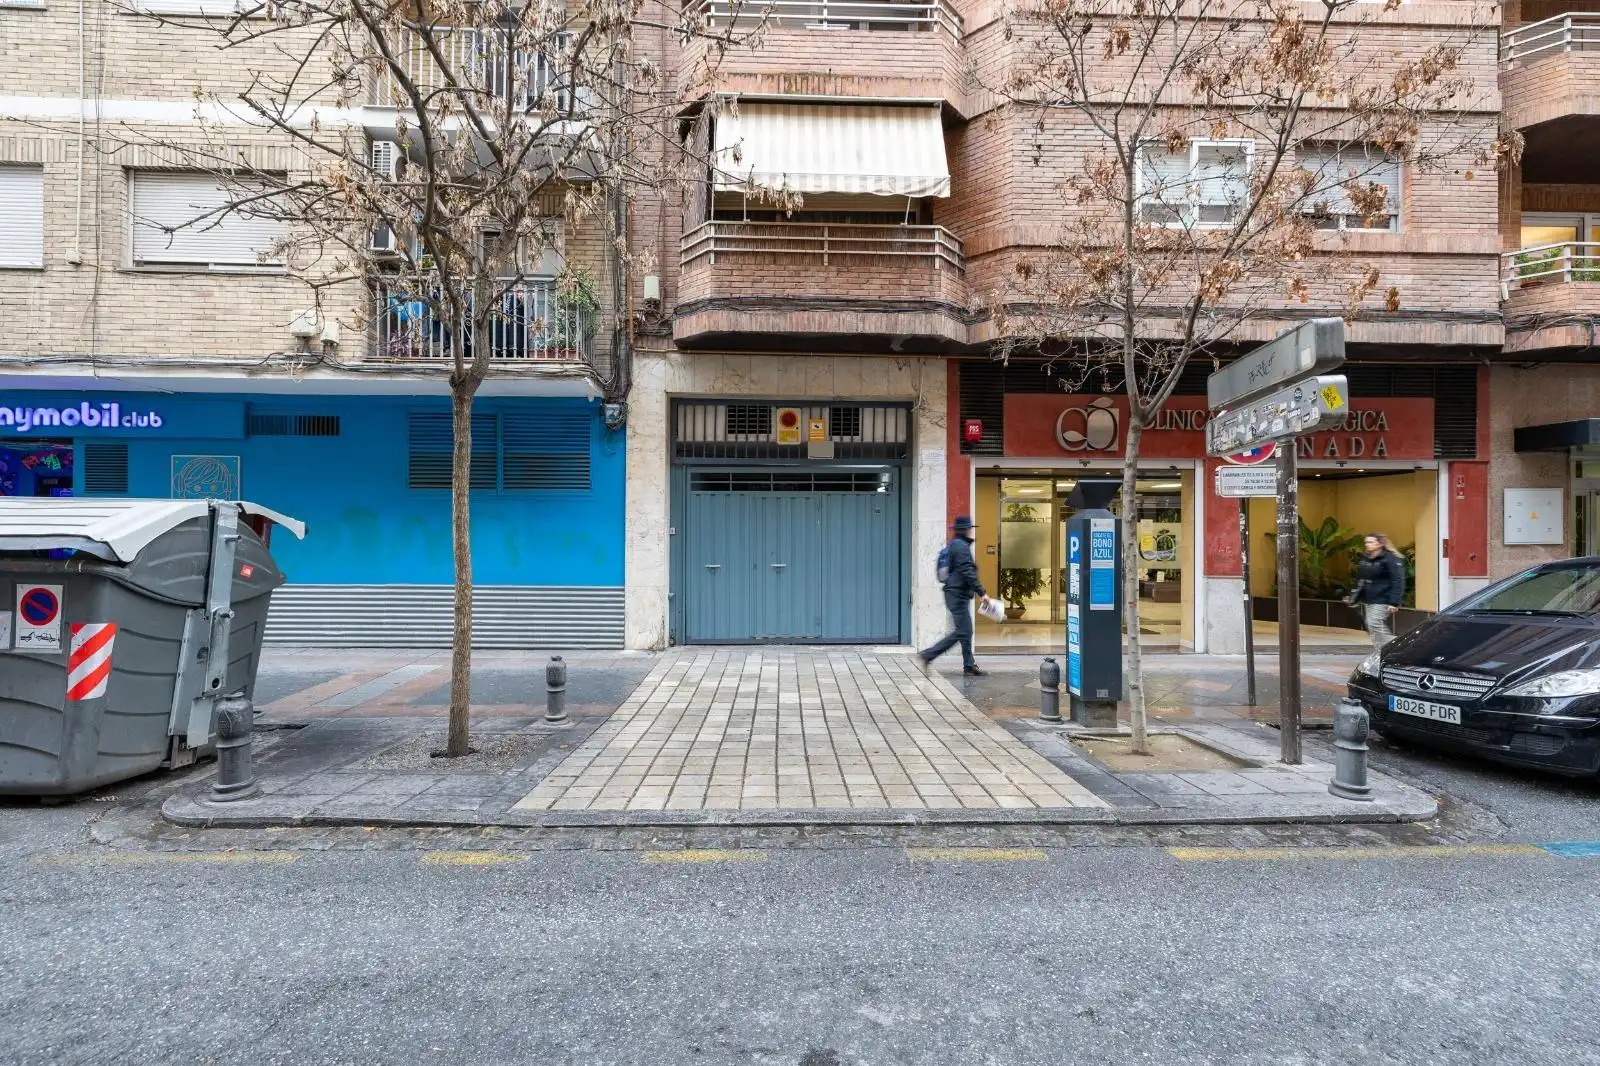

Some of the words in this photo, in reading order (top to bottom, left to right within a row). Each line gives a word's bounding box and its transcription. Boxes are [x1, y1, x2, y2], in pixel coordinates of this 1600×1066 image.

[121, 411, 162, 428] club
[1070, 536, 1080, 558] P
[1093, 538, 1113, 548] BONO
[1093, 548, 1113, 559] AZUL
[1396, 698, 1426, 715] 8026
[1429, 704, 1457, 721] FDR
